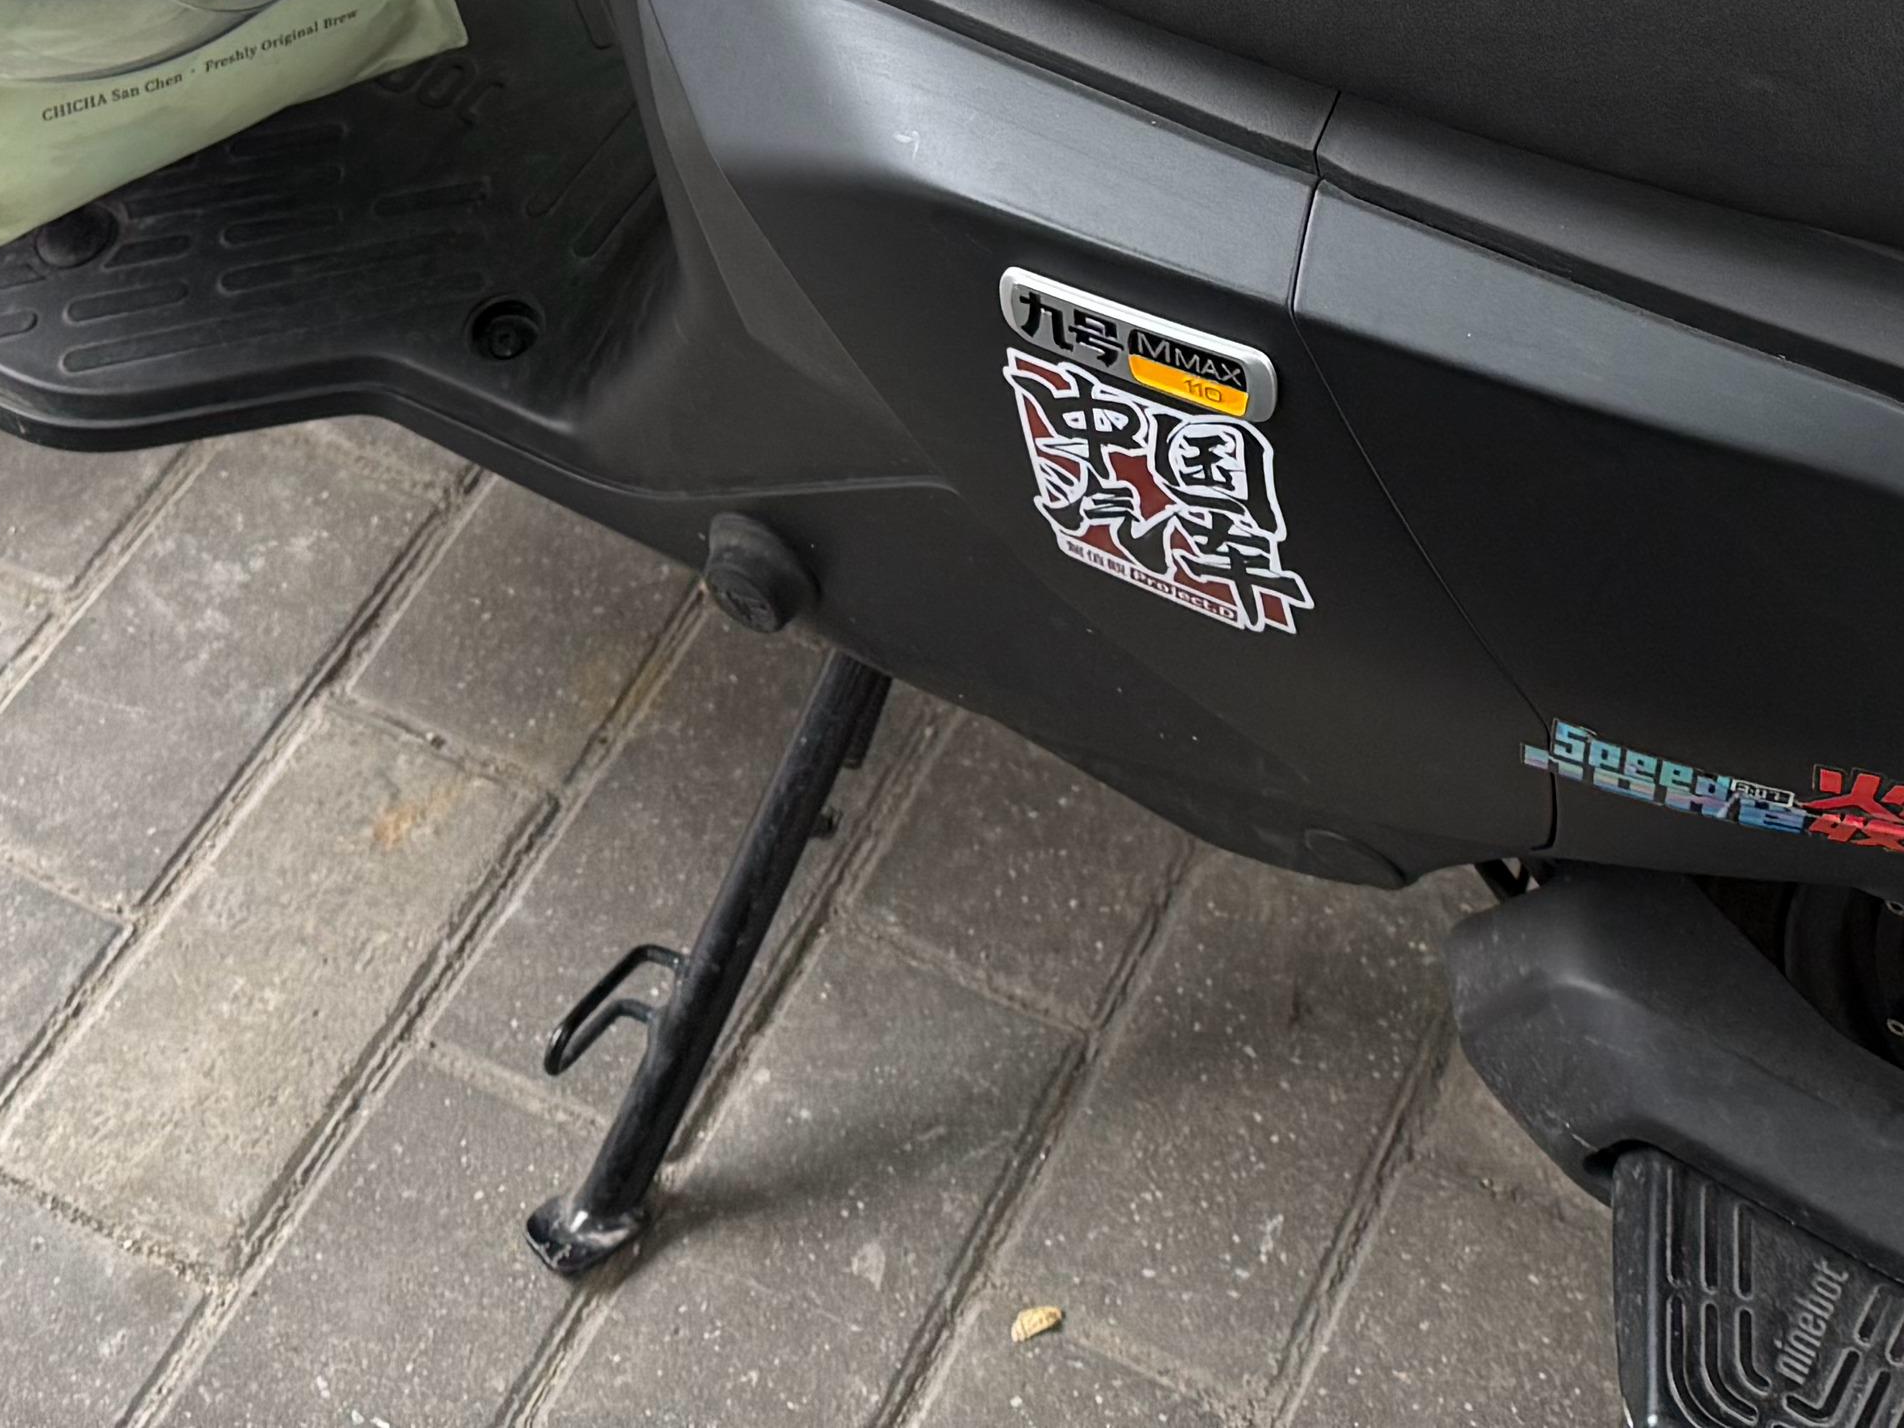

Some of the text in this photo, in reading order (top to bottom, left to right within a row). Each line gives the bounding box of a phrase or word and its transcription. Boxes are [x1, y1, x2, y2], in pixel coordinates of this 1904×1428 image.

[41, 8, 358, 122] CHICHA San Chen Freshly Original Brew
[1018, 291, 1123, 370] 九号
[1183, 377, 1223, 404] 110
[1774, 1257, 1850, 1386] ninebot
